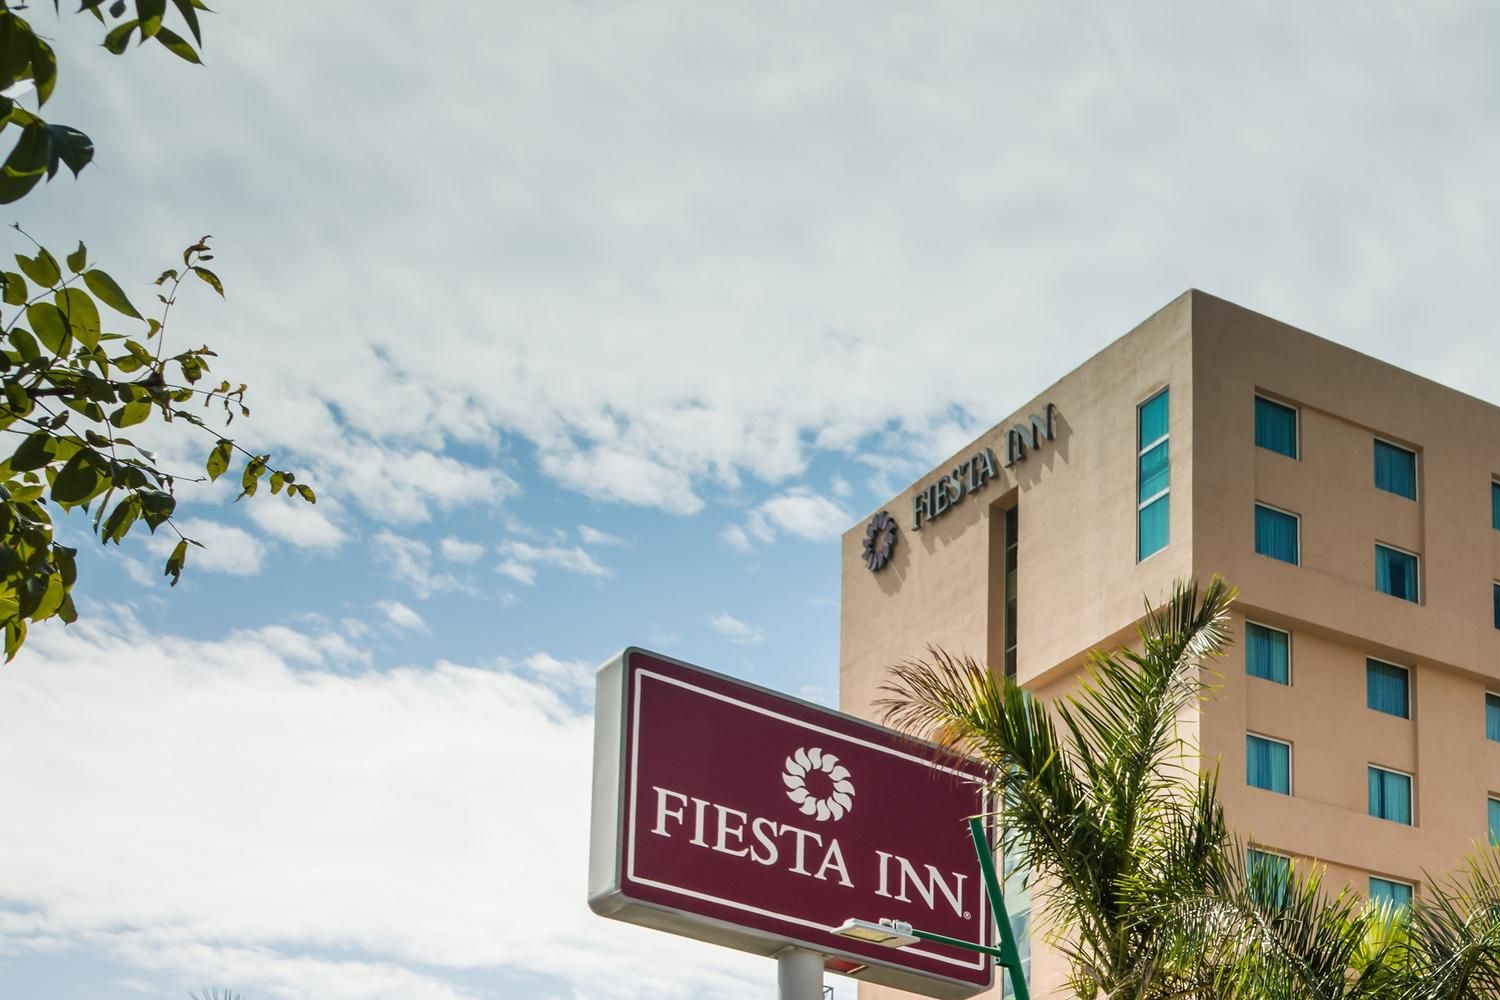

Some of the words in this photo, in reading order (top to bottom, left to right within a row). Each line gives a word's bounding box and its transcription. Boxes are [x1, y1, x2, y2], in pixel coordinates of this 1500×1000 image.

[911, 447, 999, 532] FIESTA
[1003, 402, 1057, 469] INN
[651, 785, 855, 888] FIESTA
[875, 850, 968, 918] INN
